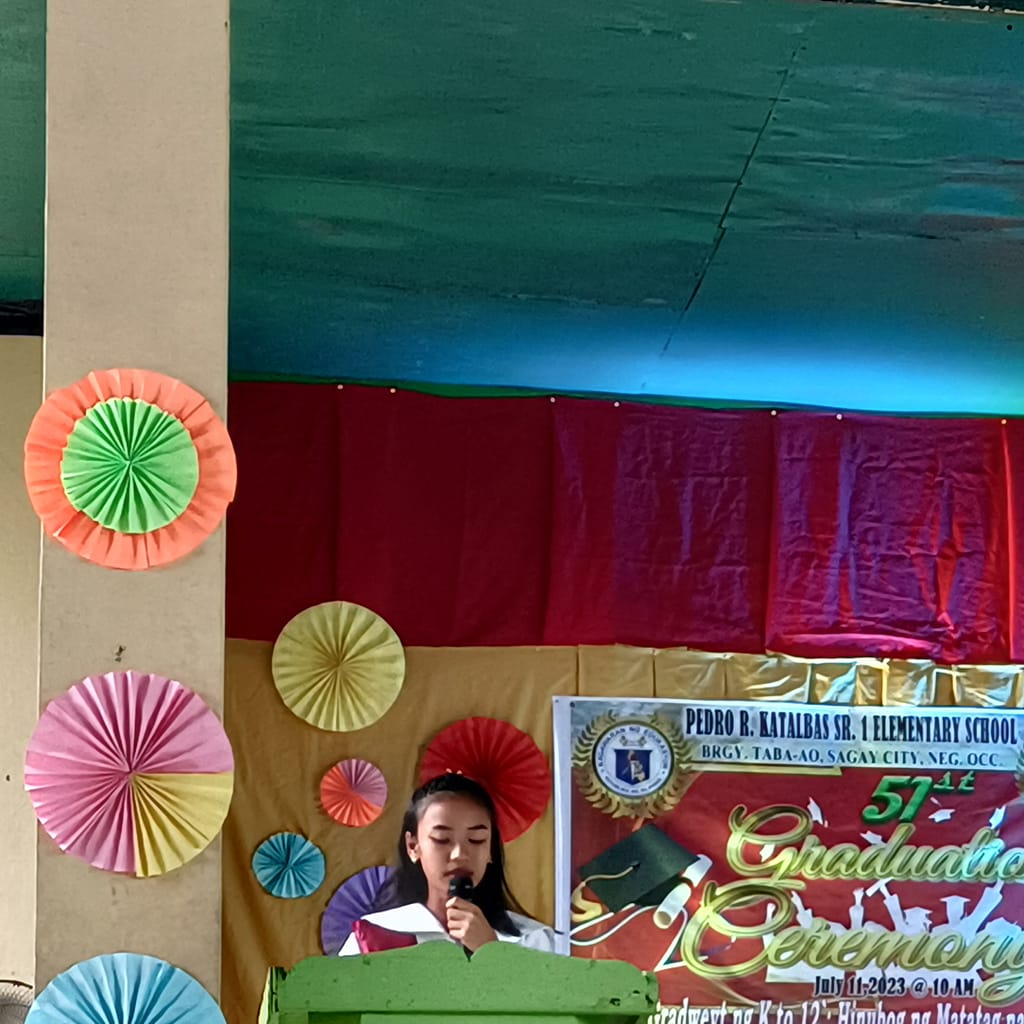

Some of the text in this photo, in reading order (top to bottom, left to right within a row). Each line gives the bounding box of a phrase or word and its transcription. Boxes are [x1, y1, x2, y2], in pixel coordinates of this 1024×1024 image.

[685, 707, 1018, 745] PEDRO R. KATALBAS SR. 1 ELEMENTARY SCHOOL
[702, 744, 748, 760] BRGY.
[829, 749, 878, 765] SAGAY
[929, 752, 963, 766] NEG.
[815, 975, 844, 996] July
[911, 977, 928, 996] @
[932, 977, 949, 996] 10
[954, 978, 975, 996] AM
